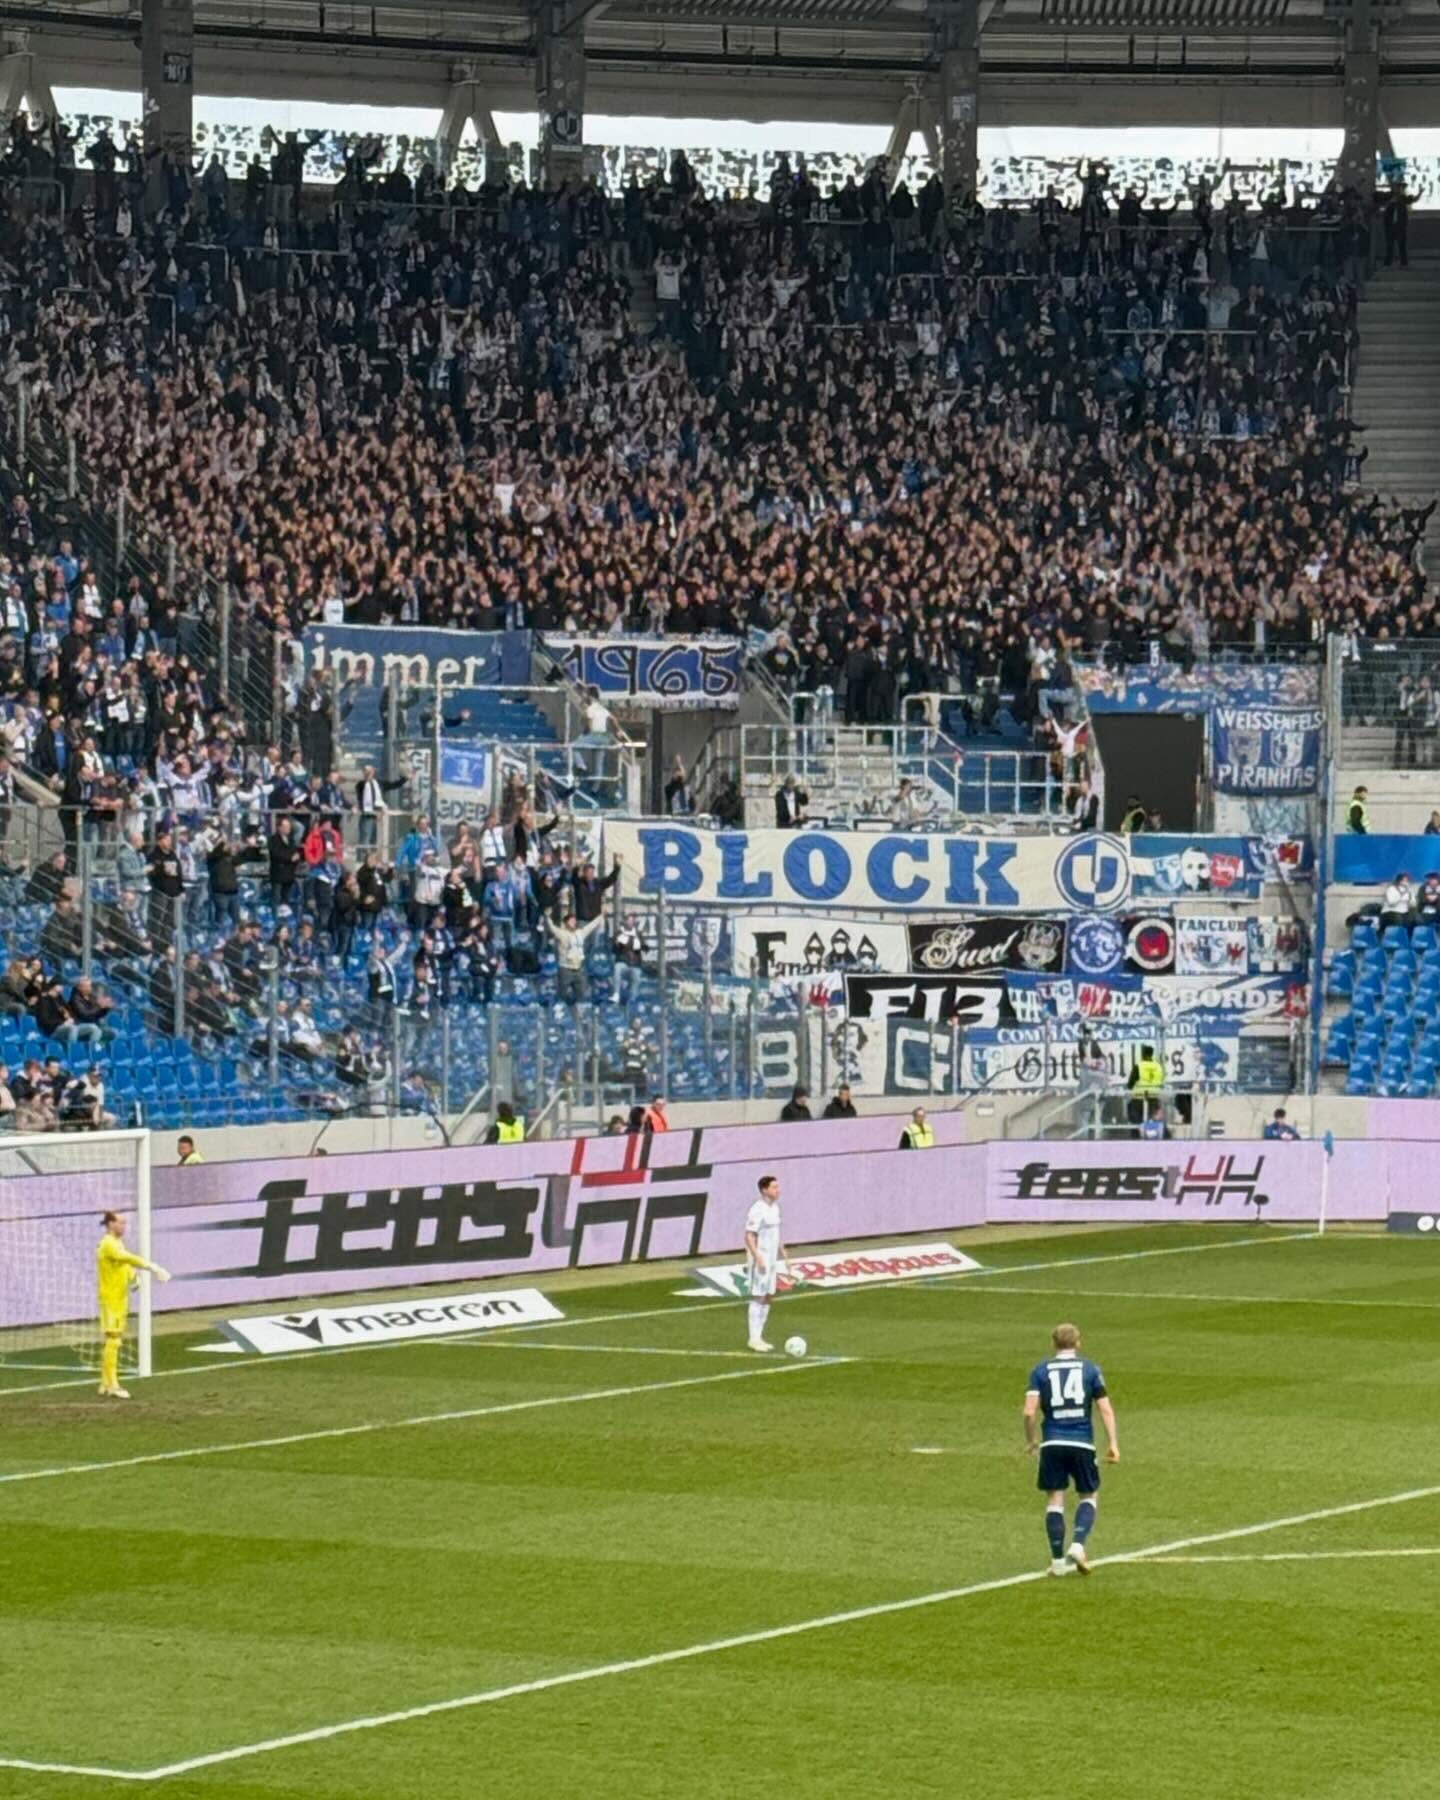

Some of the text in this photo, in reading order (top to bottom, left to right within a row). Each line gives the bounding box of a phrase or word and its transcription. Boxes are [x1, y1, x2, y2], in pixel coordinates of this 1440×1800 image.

[311, 633, 486, 688] immer
[1217, 764, 1317, 788] PIRANHAS
[637, 828, 1020, 905] BLOCK
[331, 1299, 524, 1334] macron
[1048, 1369, 1086, 1407] 14
